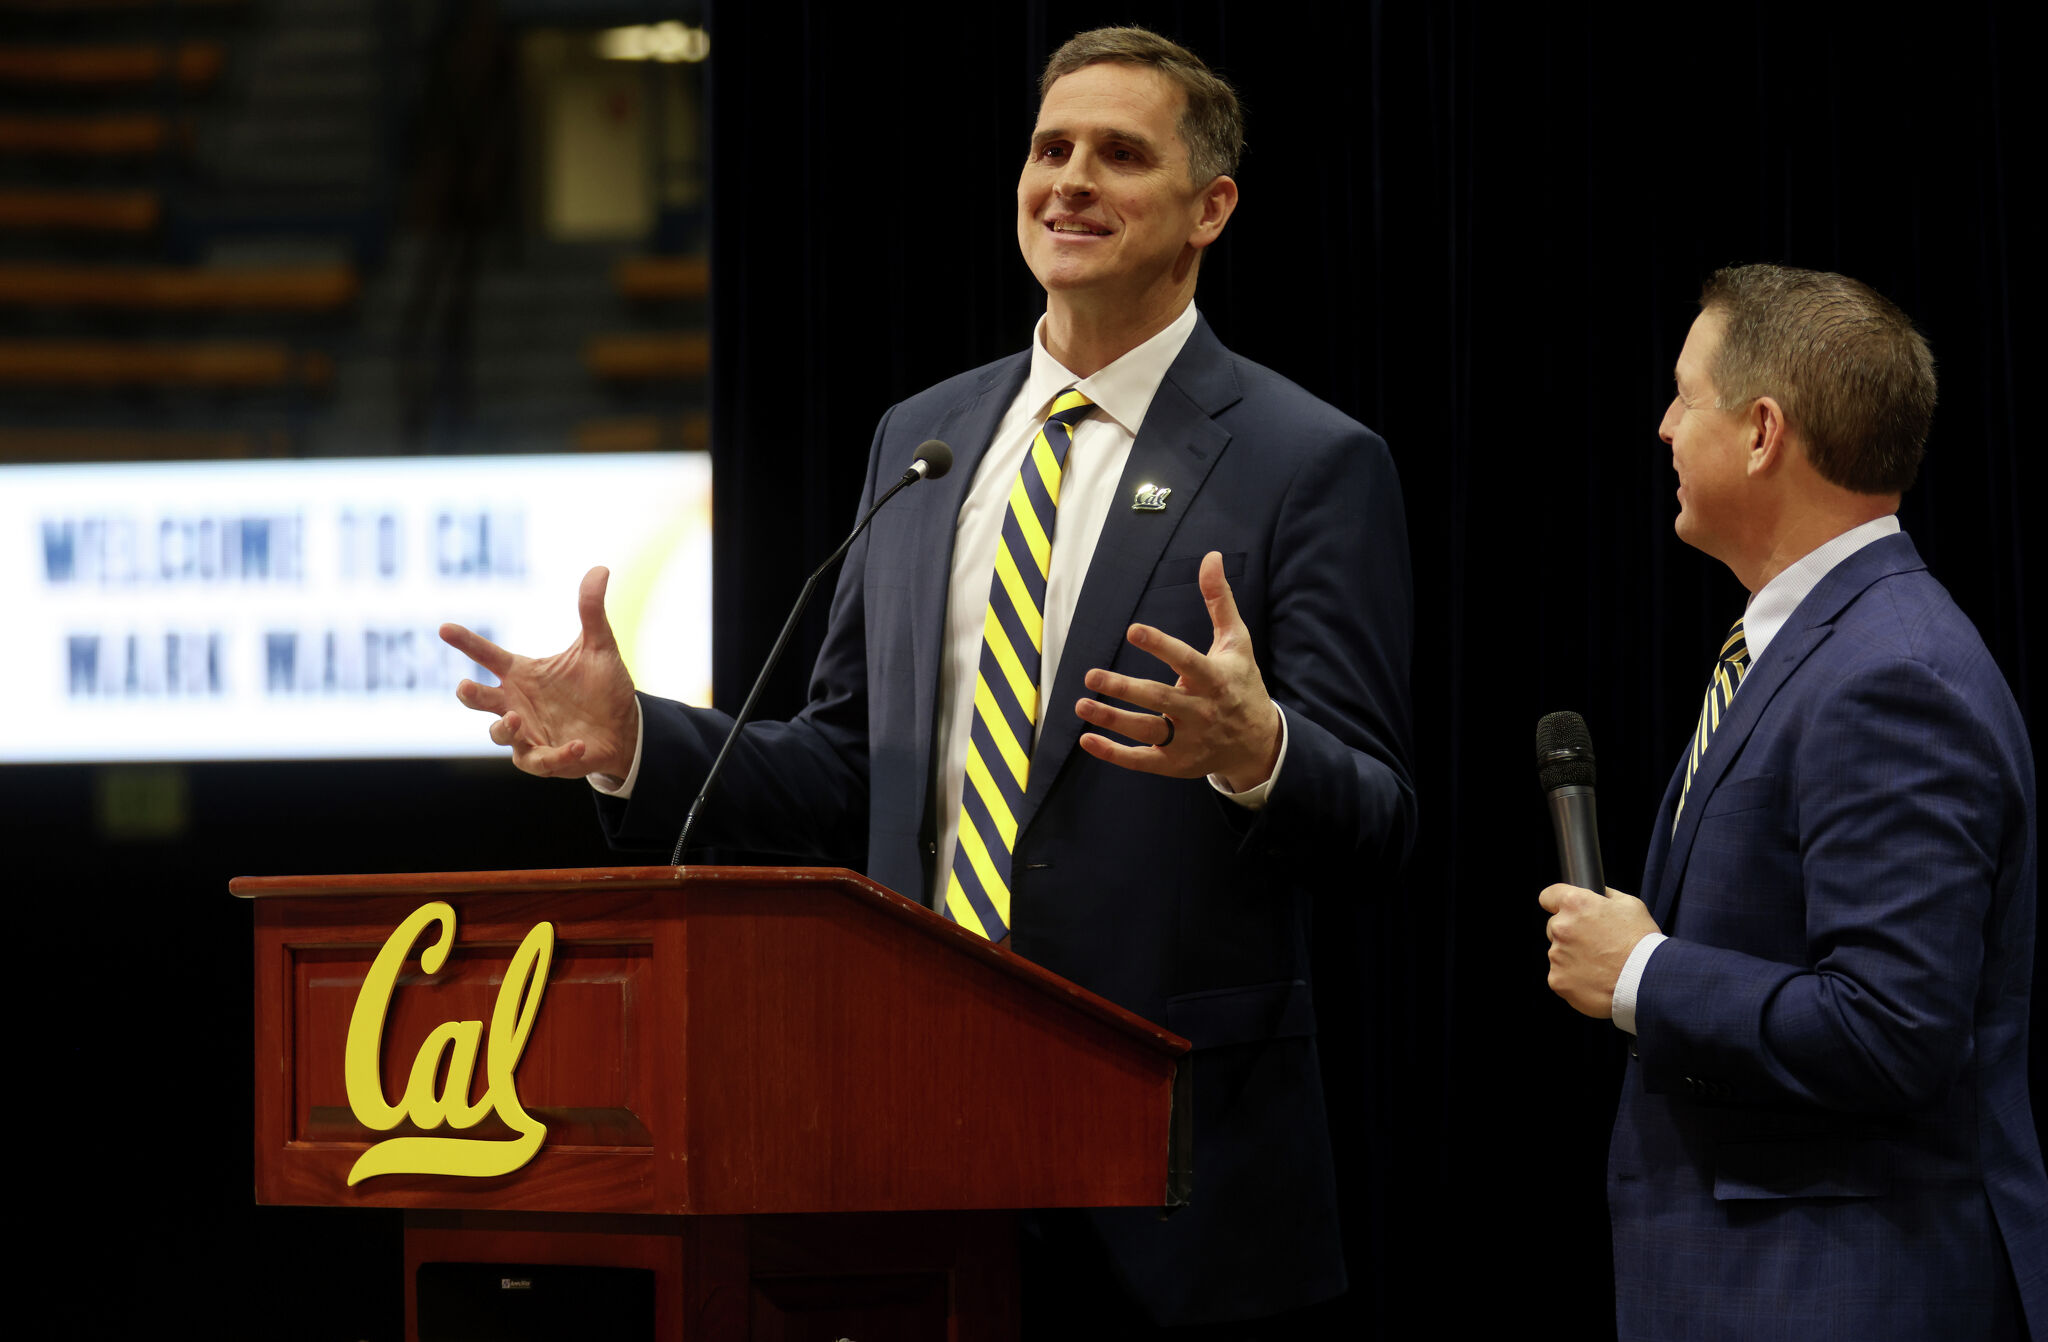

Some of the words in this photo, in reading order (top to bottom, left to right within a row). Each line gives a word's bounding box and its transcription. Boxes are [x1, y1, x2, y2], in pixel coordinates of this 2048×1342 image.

[41, 514, 304, 584] WELCOME
[338, 509, 400, 579] TO
[437, 509, 527, 578] CAL
[65, 630, 224, 695] MARK
[345, 900, 555, 1187] Cal
